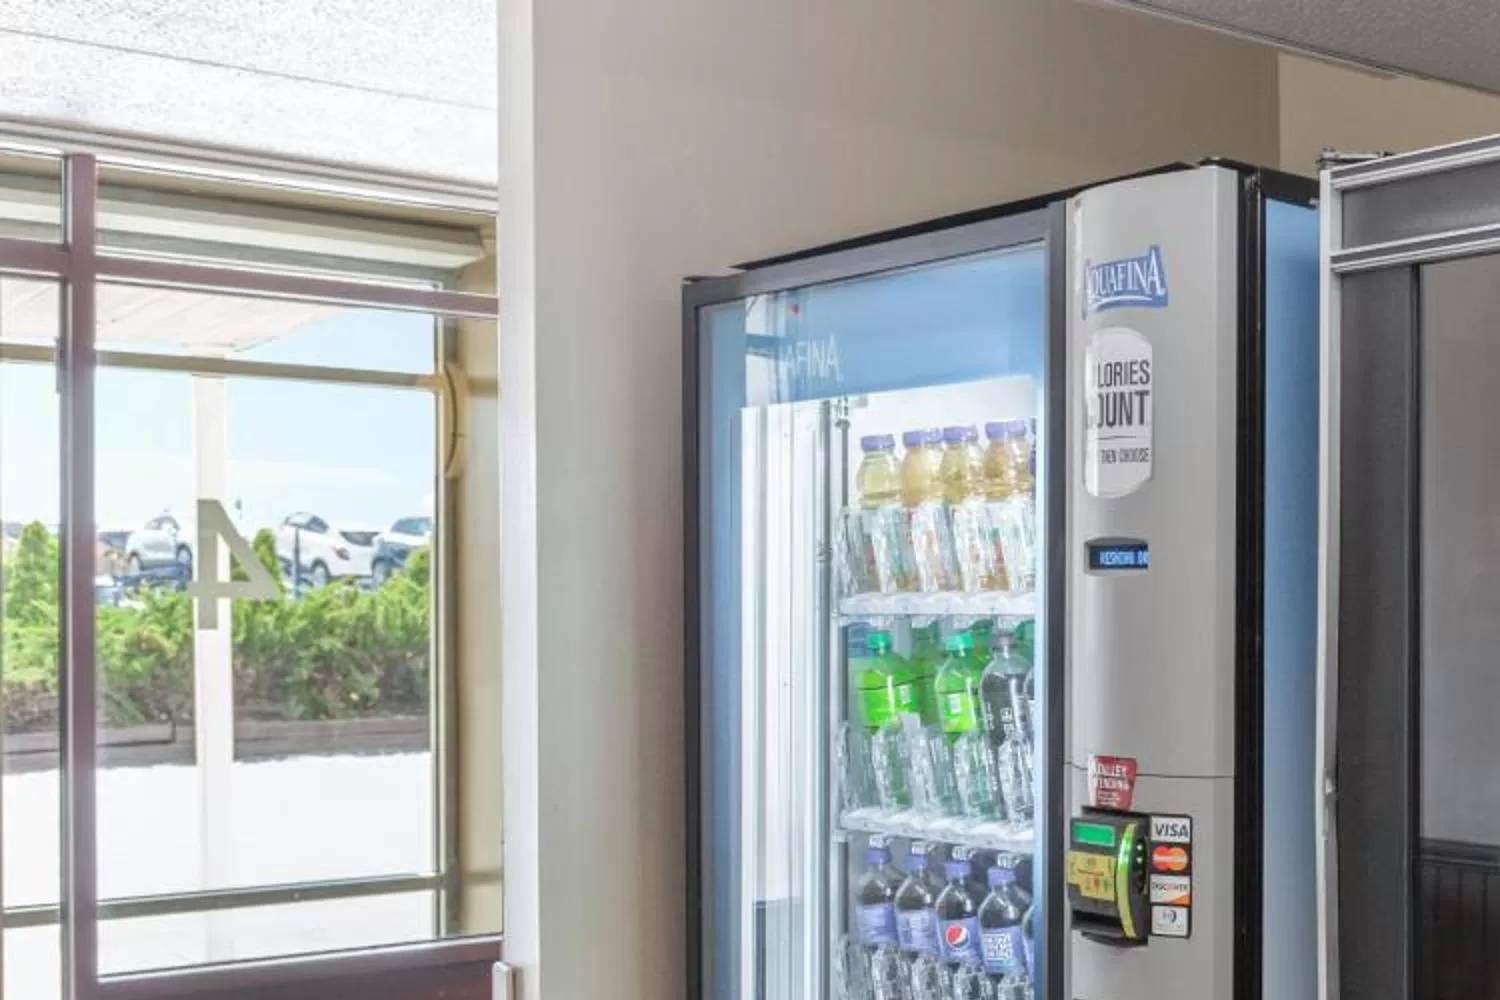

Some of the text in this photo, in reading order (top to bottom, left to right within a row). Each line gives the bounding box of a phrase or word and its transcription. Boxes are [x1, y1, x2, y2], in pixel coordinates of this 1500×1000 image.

[1097, 359, 1151, 389] LORIES
[1097, 391, 1151, 427] OUNT
[1155, 824, 1188, 838] VISA
